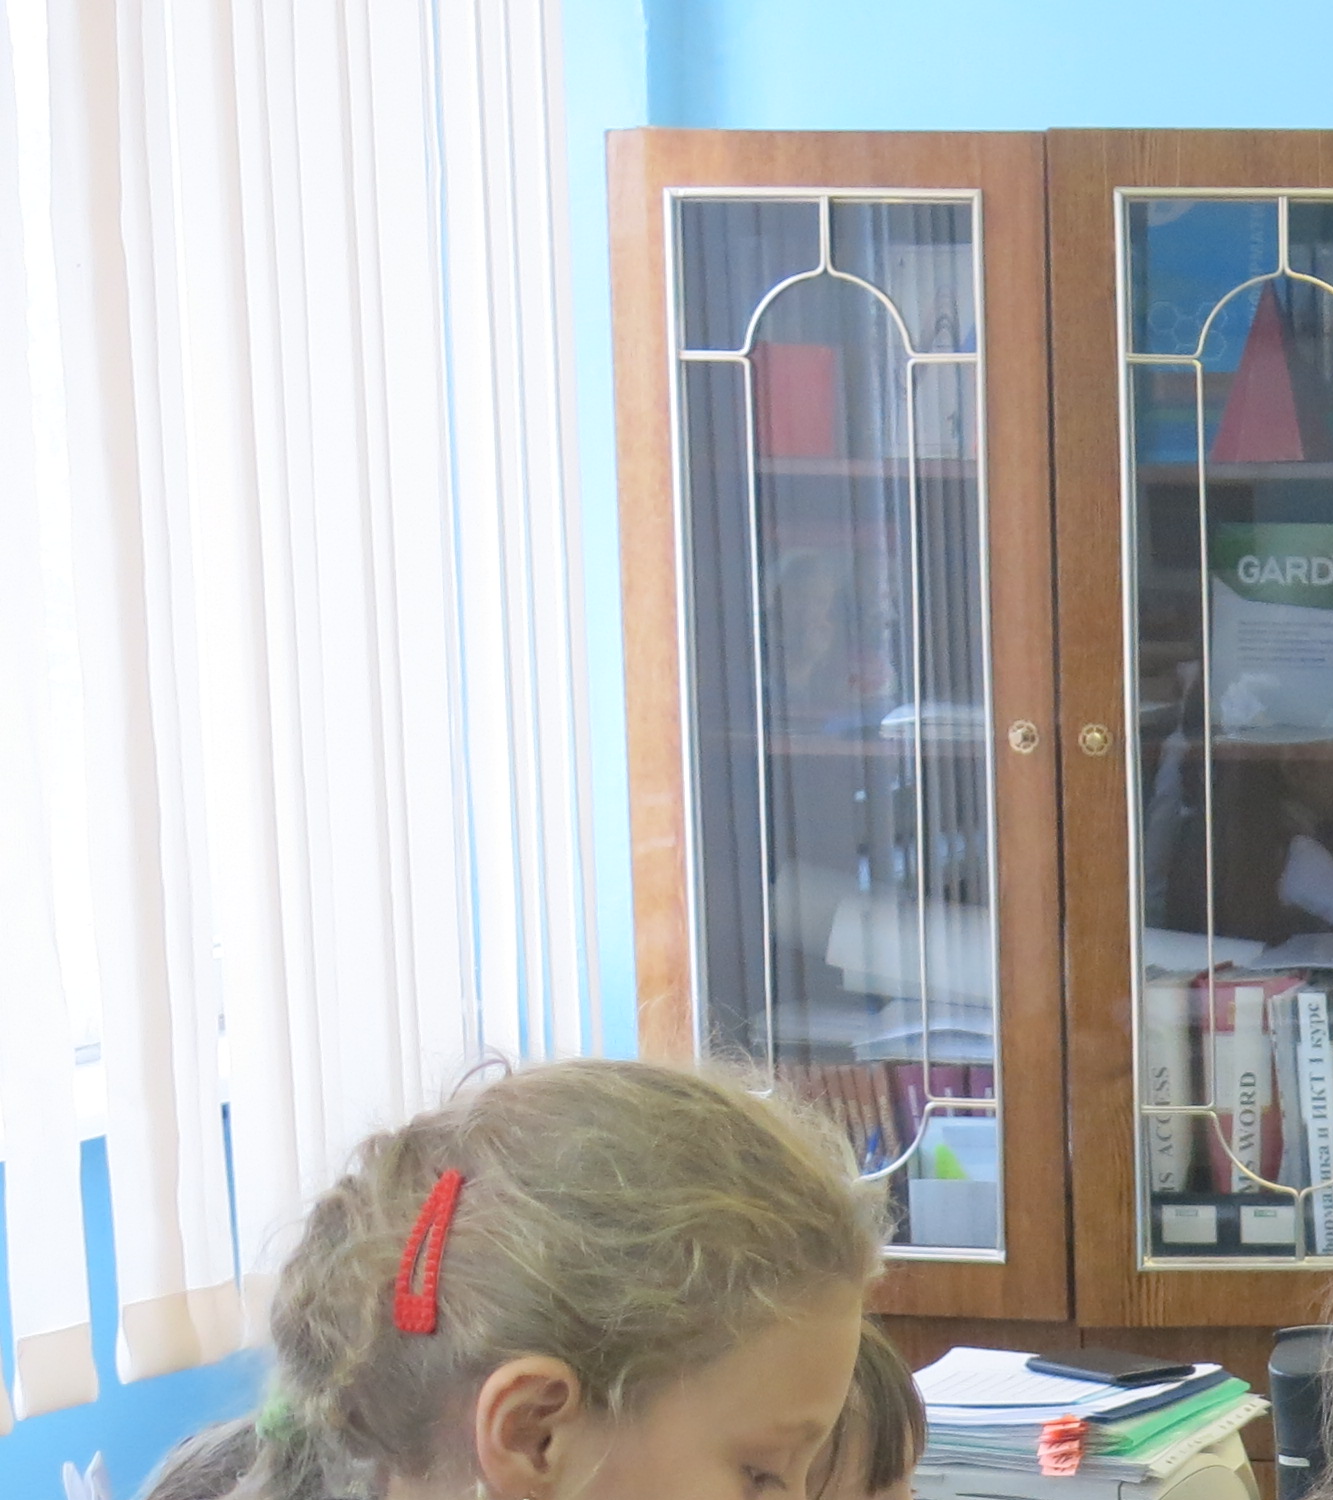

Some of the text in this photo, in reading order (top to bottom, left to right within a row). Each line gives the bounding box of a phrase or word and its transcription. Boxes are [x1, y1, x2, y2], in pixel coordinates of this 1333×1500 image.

[1307, 1003, 1327, 1048] курс
[1152, 1066, 1173, 1157] ACCESS
[1239, 1071, 1257, 1152] WORD
[1309, 1075, 1328, 1119] ИКТ
